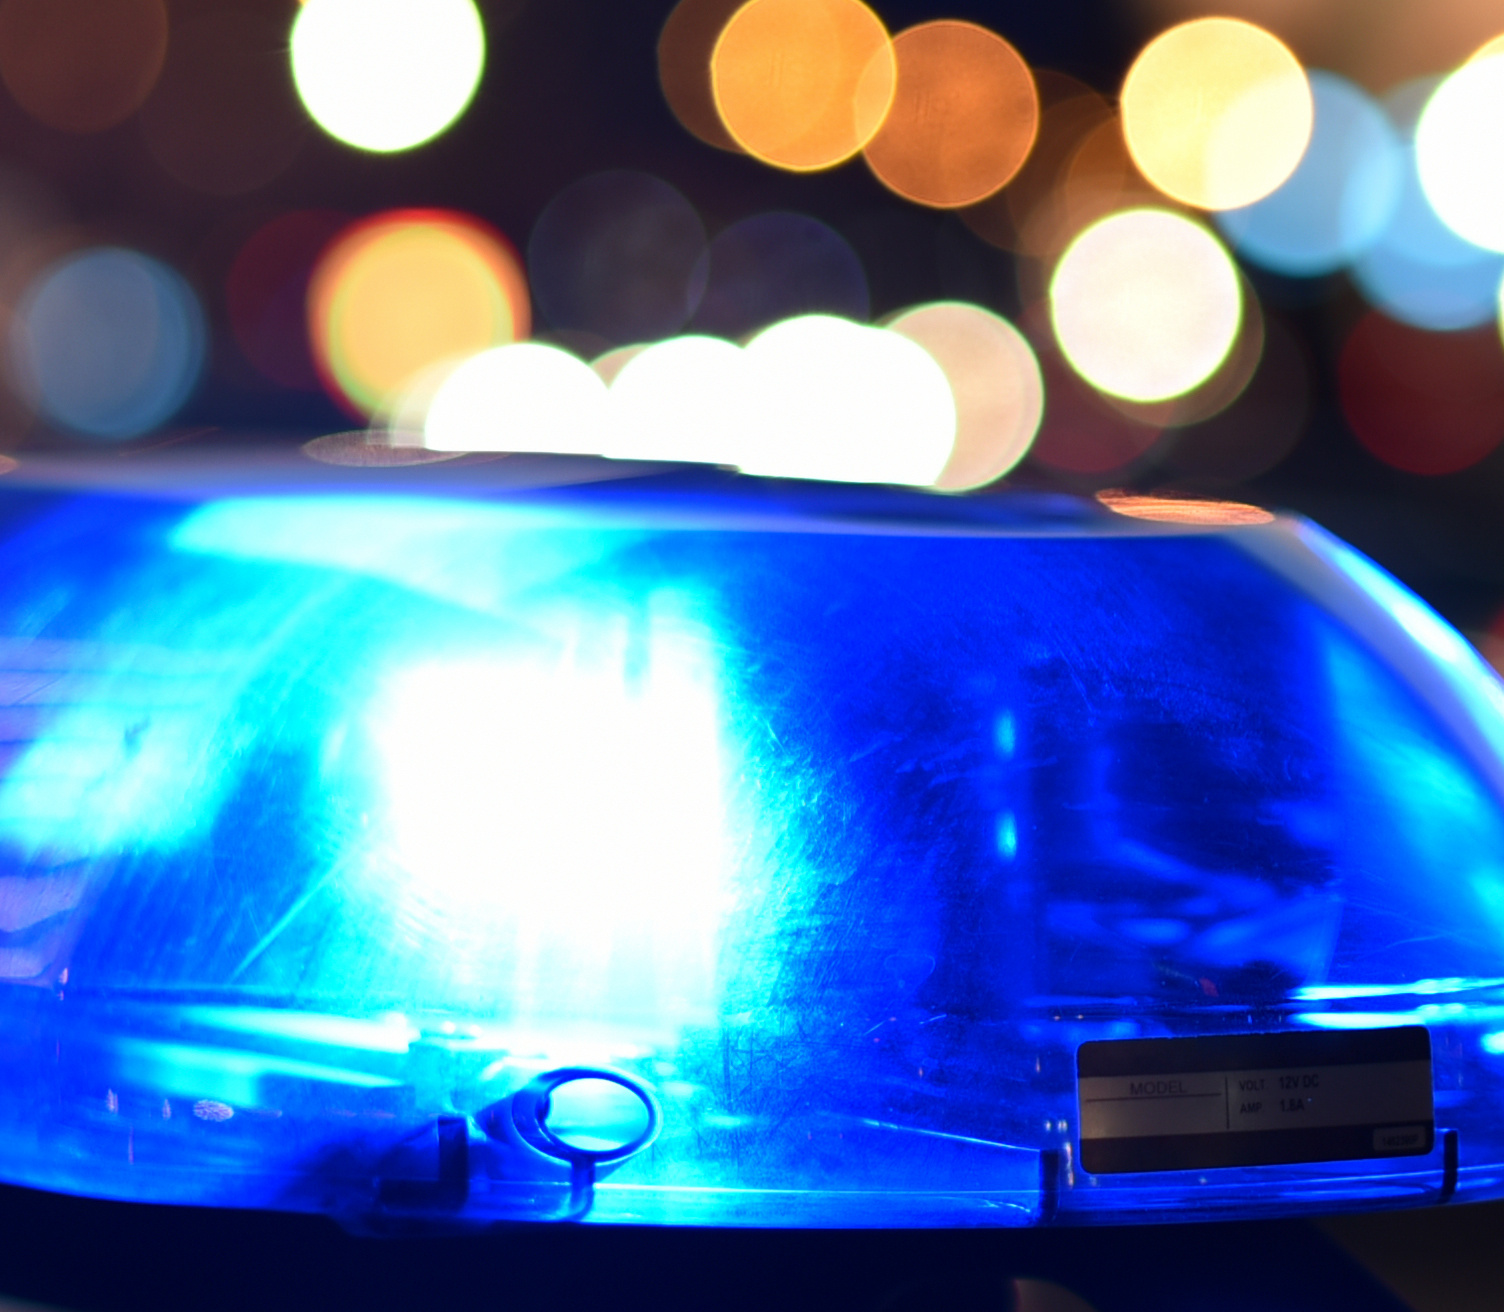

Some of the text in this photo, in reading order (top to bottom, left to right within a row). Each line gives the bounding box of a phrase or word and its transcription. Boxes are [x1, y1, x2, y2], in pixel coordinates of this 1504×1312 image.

[1129, 1079, 1188, 1095] MODEL
[1279, 1075, 1299, 1090] 12V
[1303, 1073, 1319, 1088] DC
